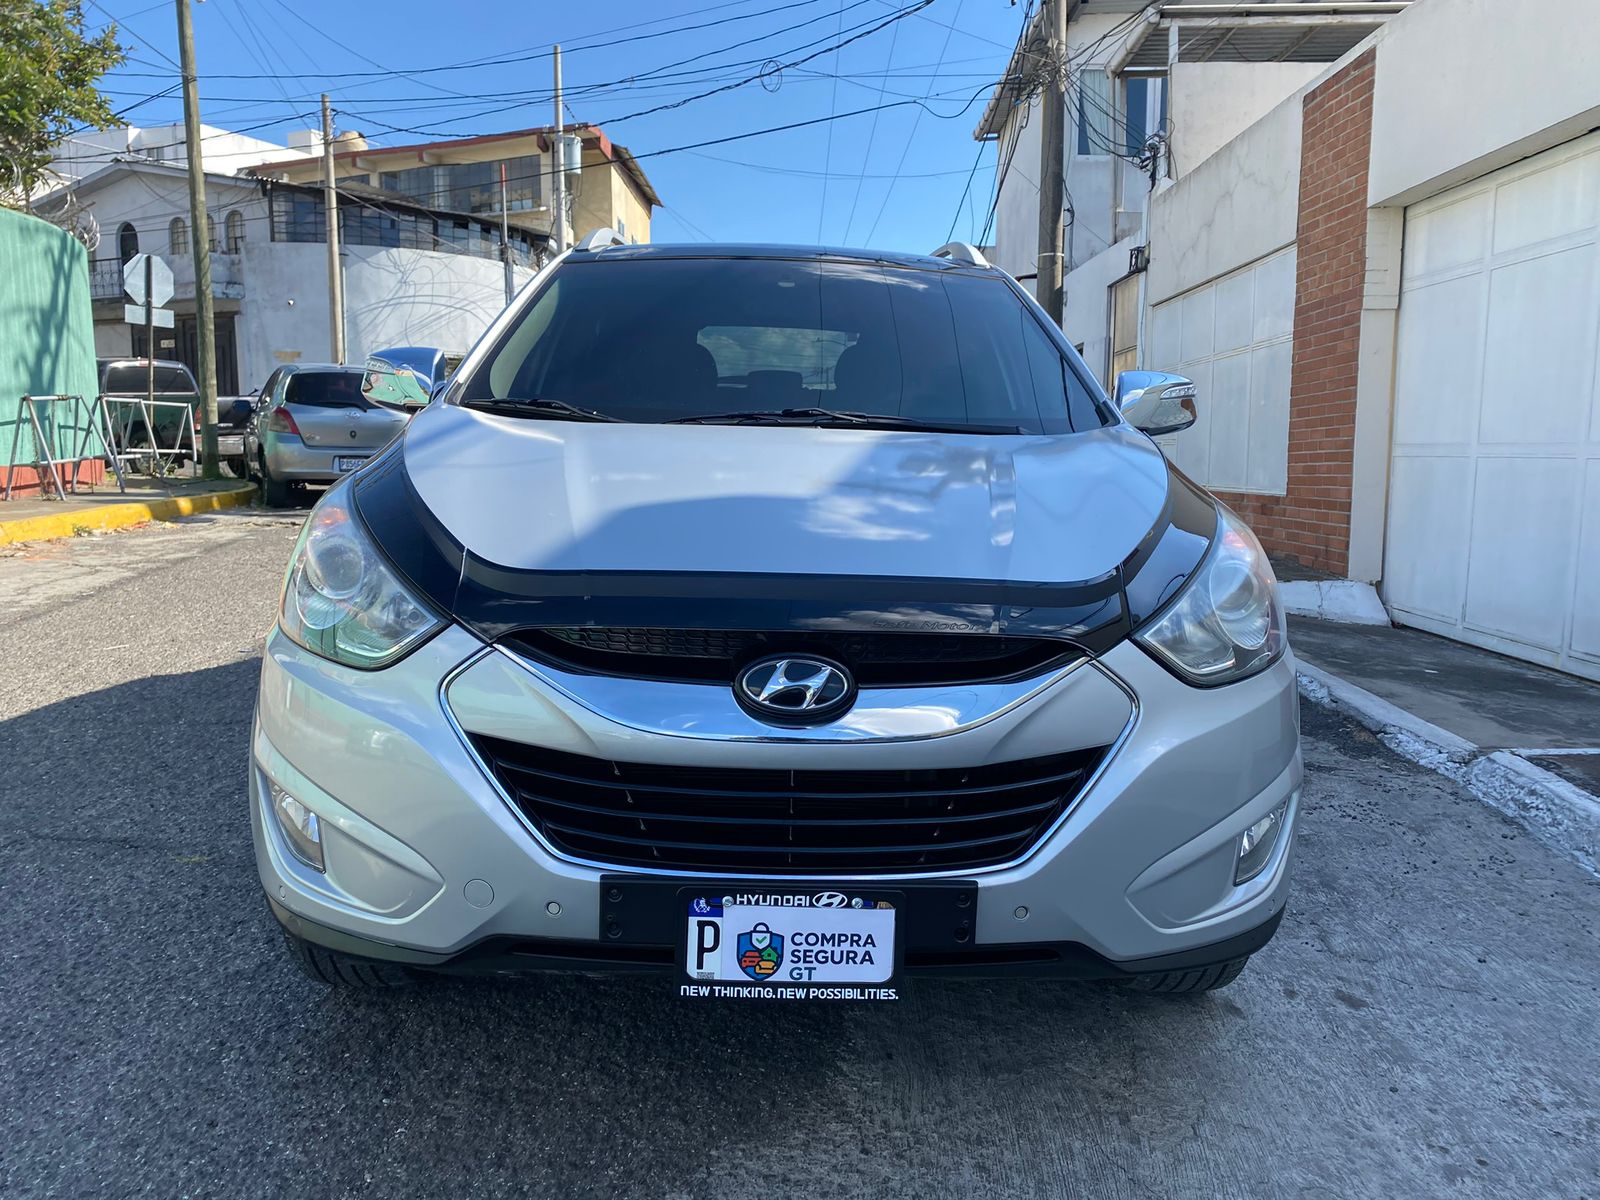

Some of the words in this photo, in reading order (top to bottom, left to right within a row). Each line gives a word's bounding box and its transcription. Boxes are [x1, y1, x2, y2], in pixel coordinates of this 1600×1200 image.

[736, 894, 809, 907] HYUNDAI
[696, 919, 721, 970] P
[790, 932, 877, 948] COMPRA
[790, 949, 875, 965] SEGURA
[789, 966, 817, 981] GT
[680, 985, 711, 997] NEW
[809, 988, 899, 1000] POSSIBILITIES.
